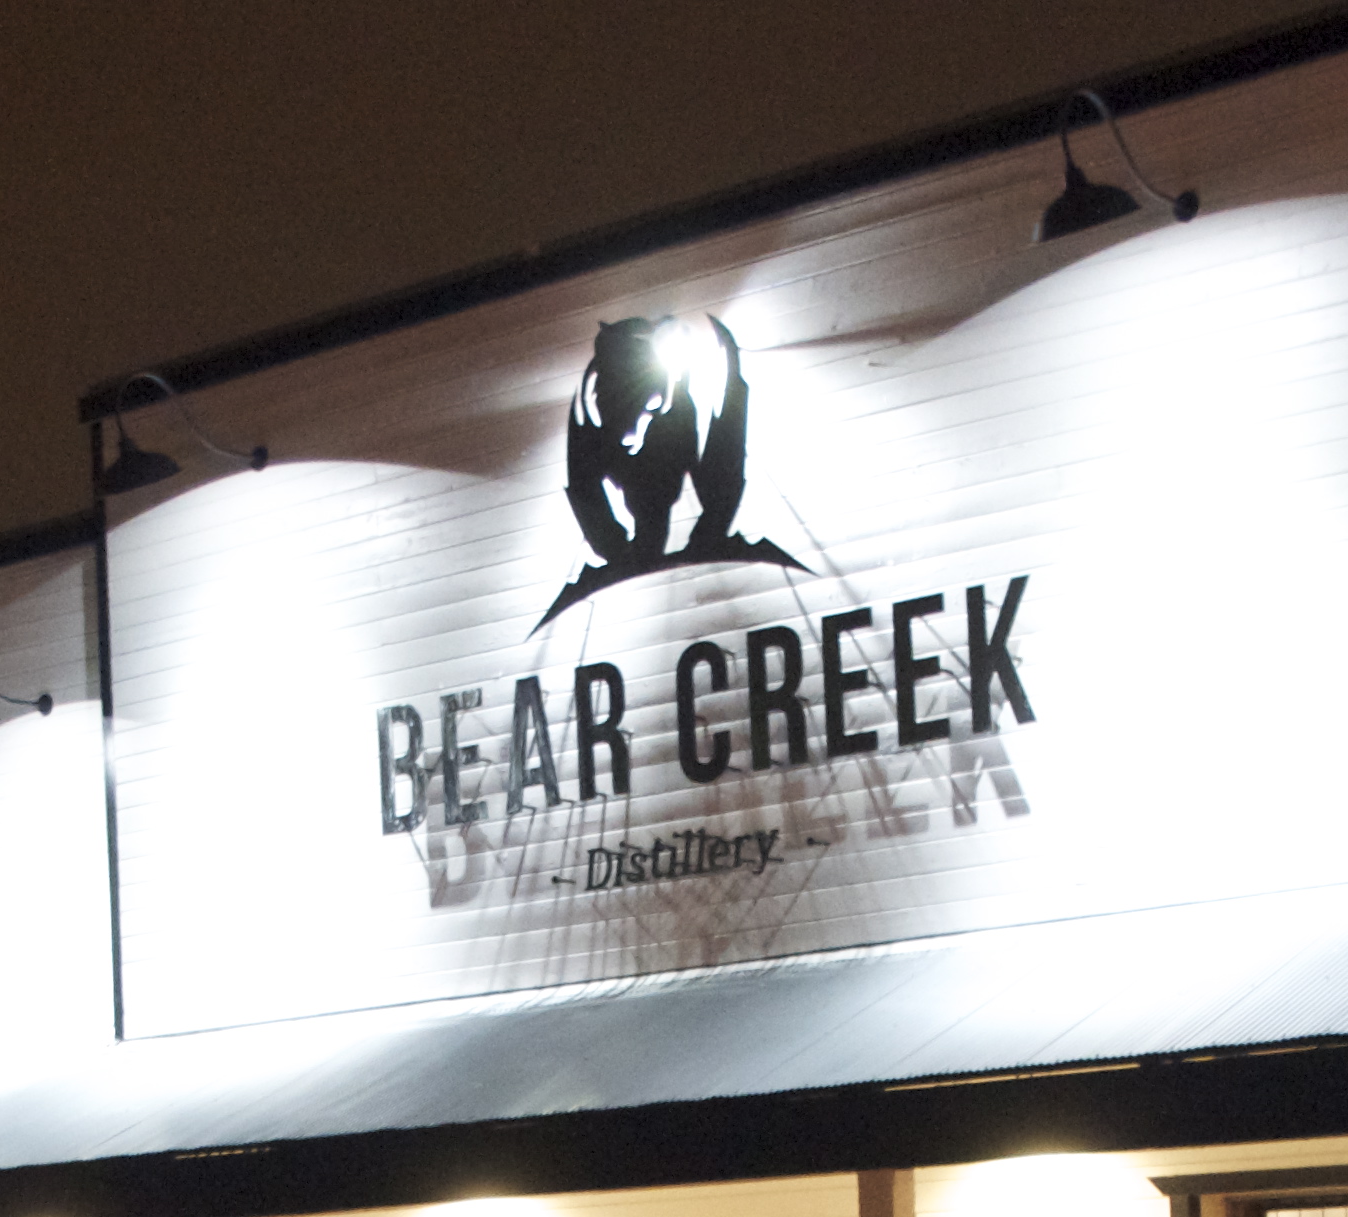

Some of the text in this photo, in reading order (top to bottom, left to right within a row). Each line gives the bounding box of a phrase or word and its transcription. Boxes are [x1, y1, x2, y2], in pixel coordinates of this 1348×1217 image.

[376, 575, 1036, 836] BEAR CREEK
[585, 828, 783, 891] Distillery
